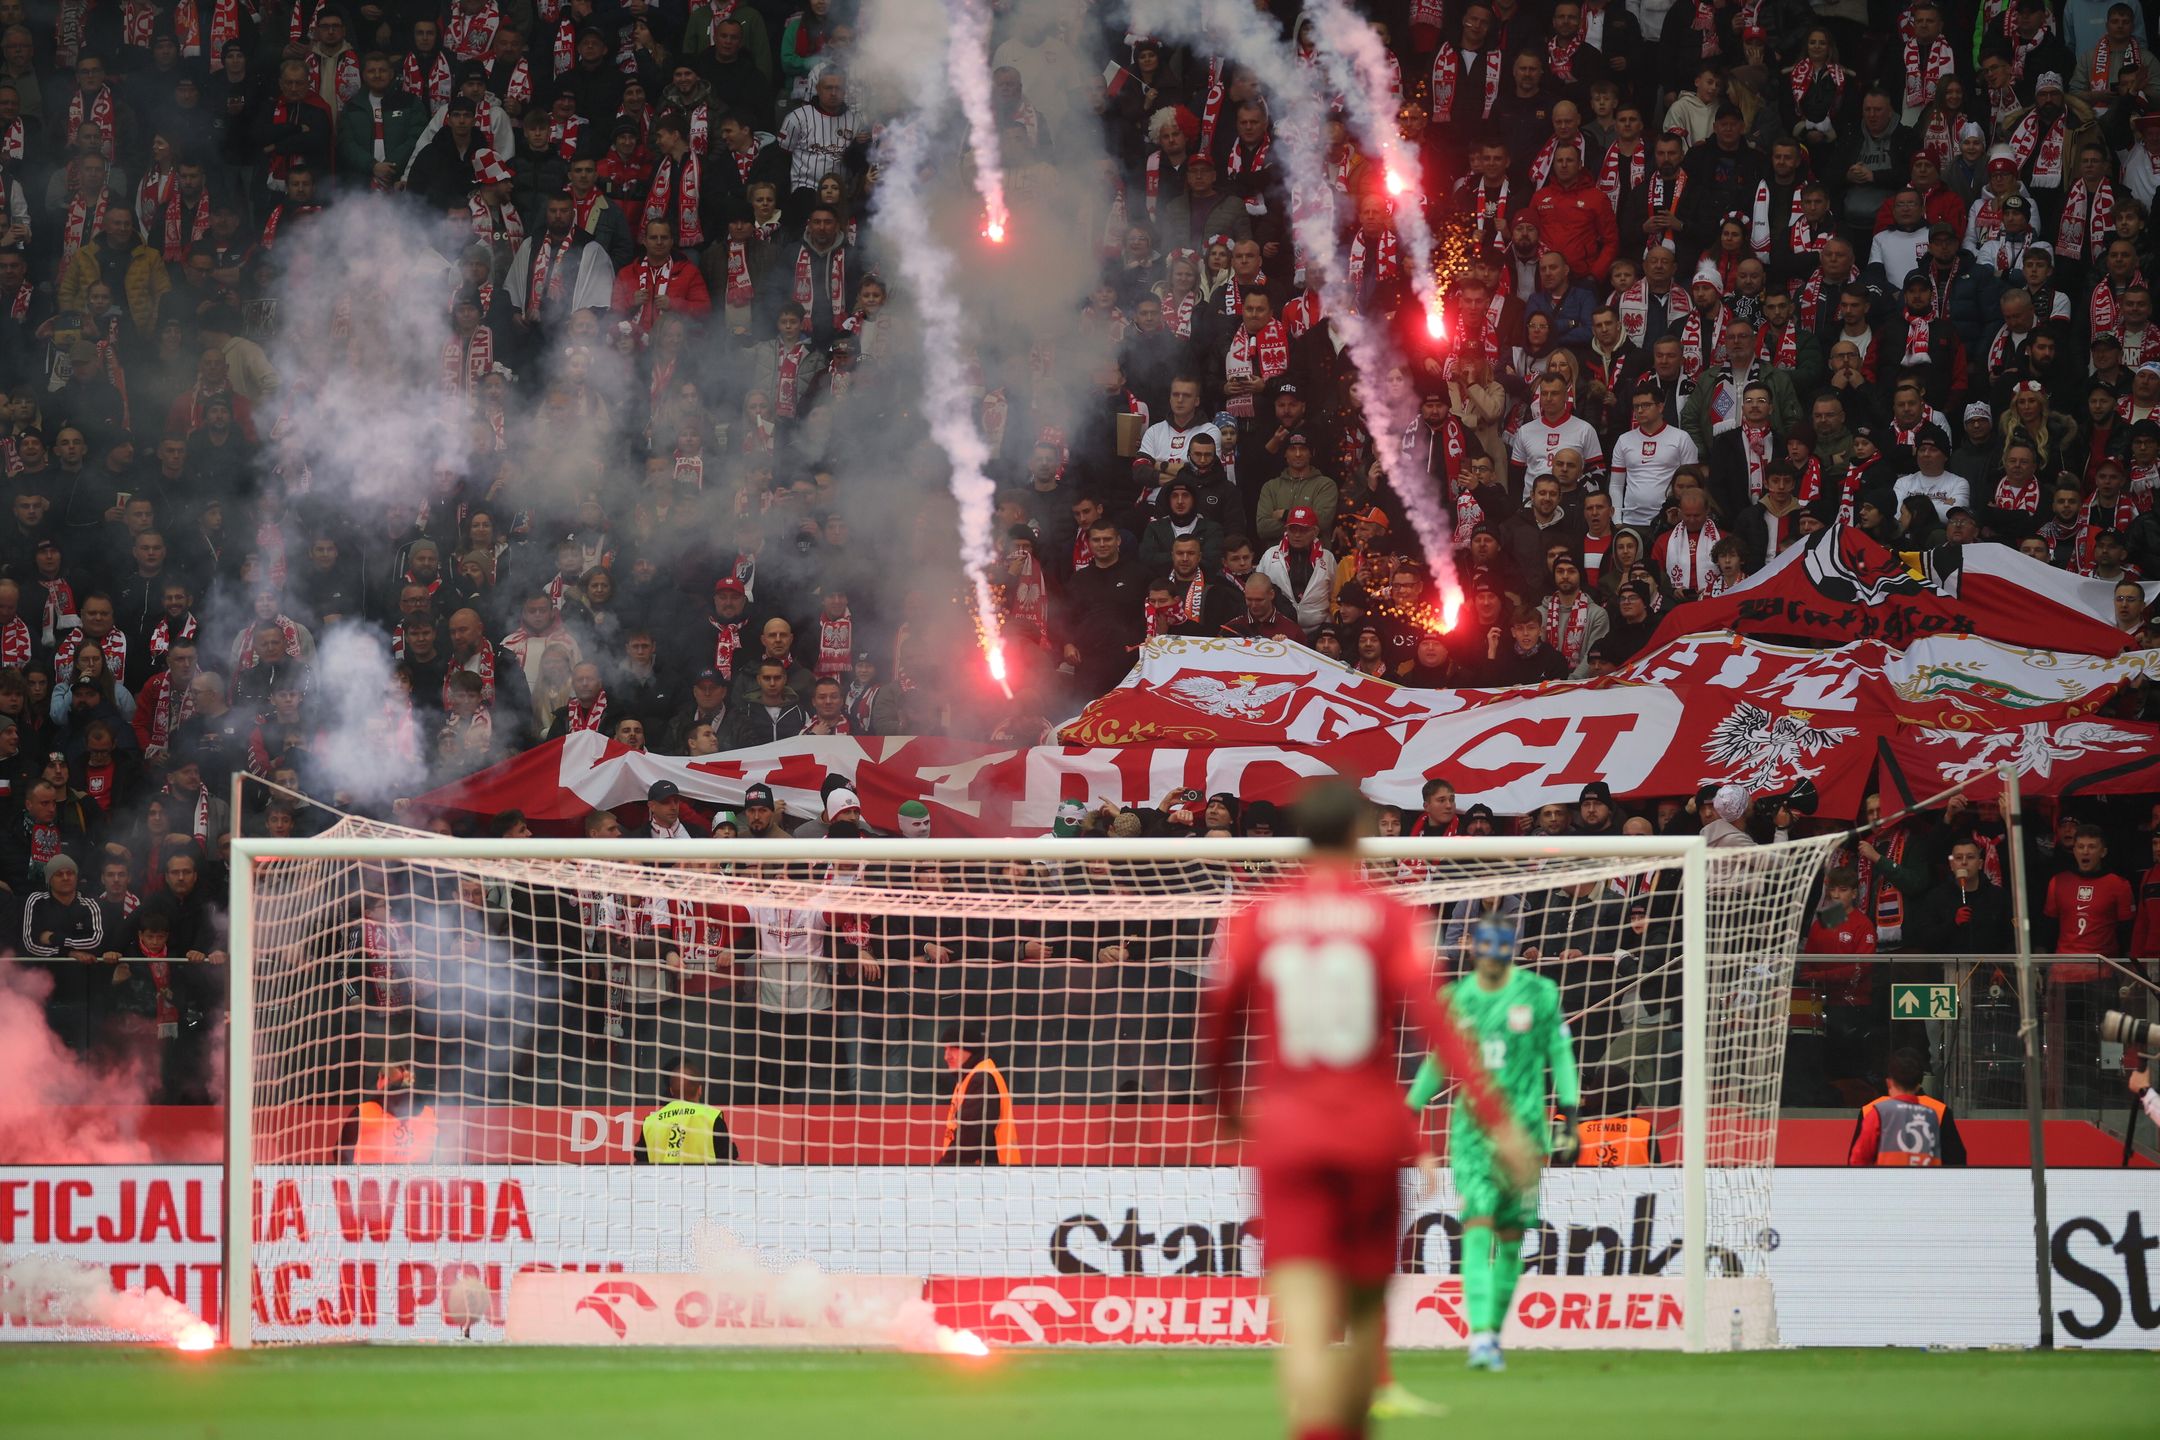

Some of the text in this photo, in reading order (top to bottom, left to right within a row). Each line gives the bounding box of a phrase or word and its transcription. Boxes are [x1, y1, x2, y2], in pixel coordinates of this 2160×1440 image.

[2077, 917, 2087, 936] 9
[658, 1108, 696, 1121] STEWARD
[1586, 1122, 1628, 1133] STEWARD
[0, 1178, 533, 1244] FICJALA WODA
[1091, 1295, 1270, 1336] ORLEN
[1517, 1291, 1685, 1330] ORLEN
